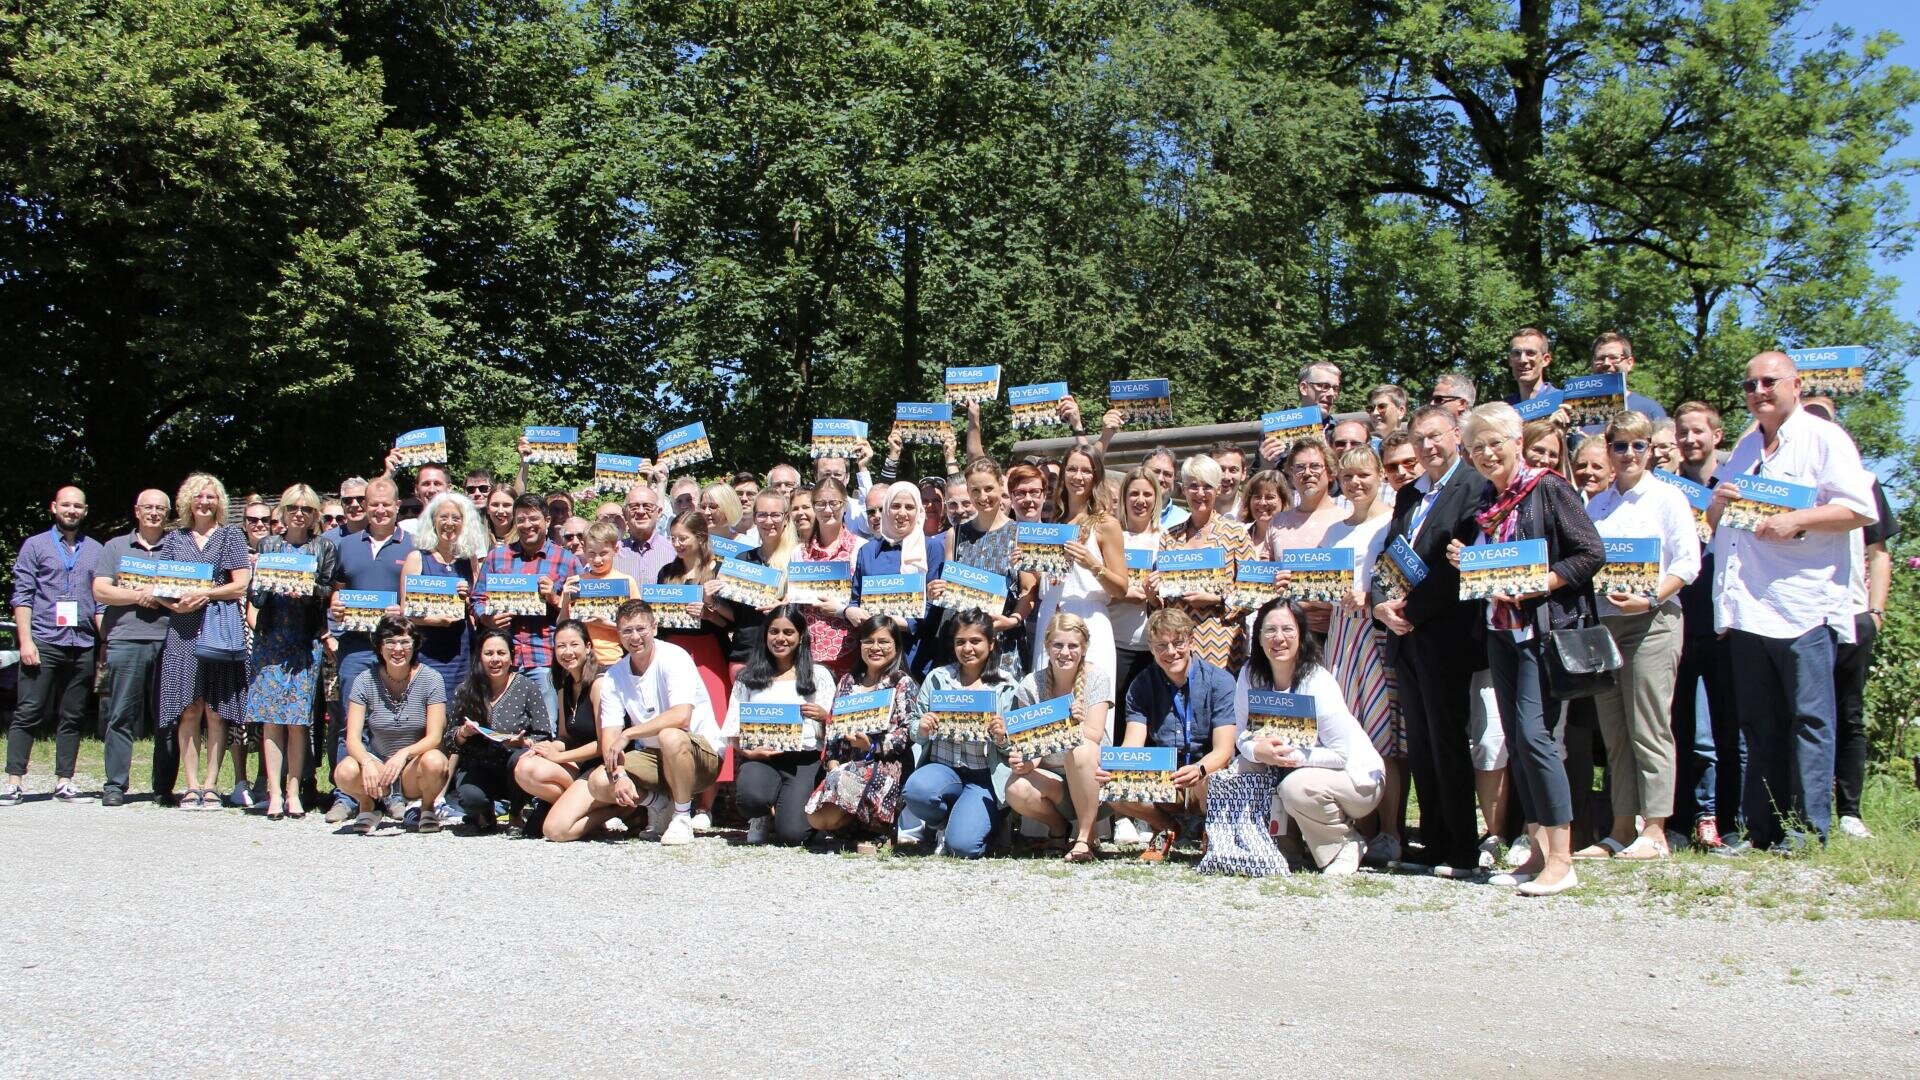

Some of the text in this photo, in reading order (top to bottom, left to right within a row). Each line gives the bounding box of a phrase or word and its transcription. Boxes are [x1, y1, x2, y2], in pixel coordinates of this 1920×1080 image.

[1802, 351, 1838, 361] YEARS
[1121, 384, 1149, 392] YEARS
[1565, 379, 1603, 392] 20 YEARS
[1022, 387, 1049, 396] YEARS
[1521, 399, 1550, 414] YEARS
[1275, 412, 1302, 422] YEARS
[664, 431, 688, 442] YEARS
[609, 458, 632, 466] YEARS
[1735, 478, 1748, 489] 20
[1750, 481, 1789, 496] YEARS
[1030, 528, 1058, 536] YEARS
[712, 540, 737, 552] YEARS
[1393, 540, 1404, 554] 20
[1604, 543, 1634, 553] EARS
[1171, 553, 1203, 562] YEARS
[1298, 553, 1331, 562] YEARS
[1462, 547, 1518, 561] 20 YEARS
[171, 564, 196, 573] YEARS
[736, 564, 762, 576] YEARS
[1240, 565, 1250, 573] 20
[944, 565, 956, 574] 20
[959, 568, 989, 583] YEARS
[419, 579, 446, 587] YEARS
[875, 578, 905, 586] YEARS
[846, 696, 874, 705] YEARS
[944, 695, 975, 703] YEARS
[1249, 695, 1294, 707] 20 YEARS
[740, 707, 784, 716] 20 YEARS
[1007, 715, 1018, 725] 20
[1020, 706, 1054, 719] YEARS
[1102, 752, 1152, 761] 20 YEARS
